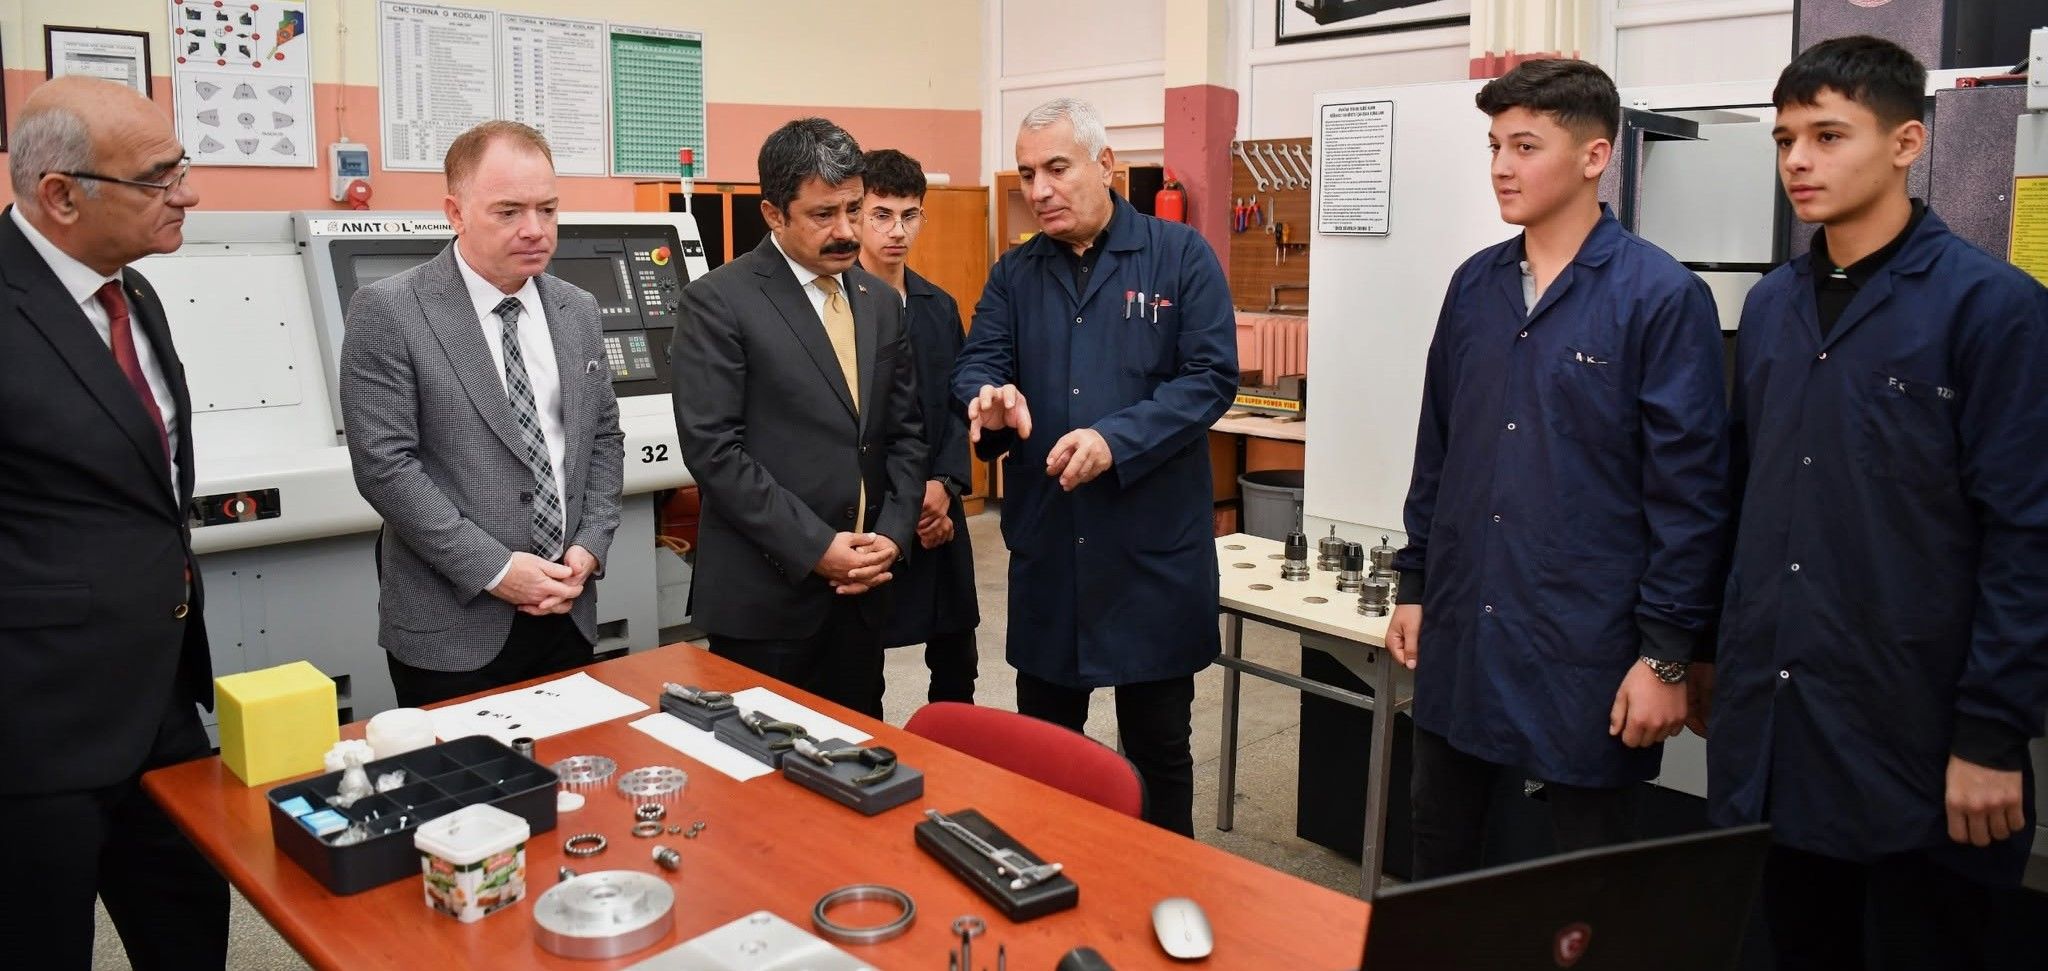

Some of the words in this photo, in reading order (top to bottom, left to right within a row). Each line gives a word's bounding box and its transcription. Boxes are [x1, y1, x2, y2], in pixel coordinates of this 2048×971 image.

[392, 5, 409, 14] CNC
[412, 7, 439, 16] TORNA
[452, 11, 487, 20] KODLARI
[1245, 396, 1262, 405] SUPER
[1263, 399, 1282, 408] POWER
[641, 444, 669, 464] 32
